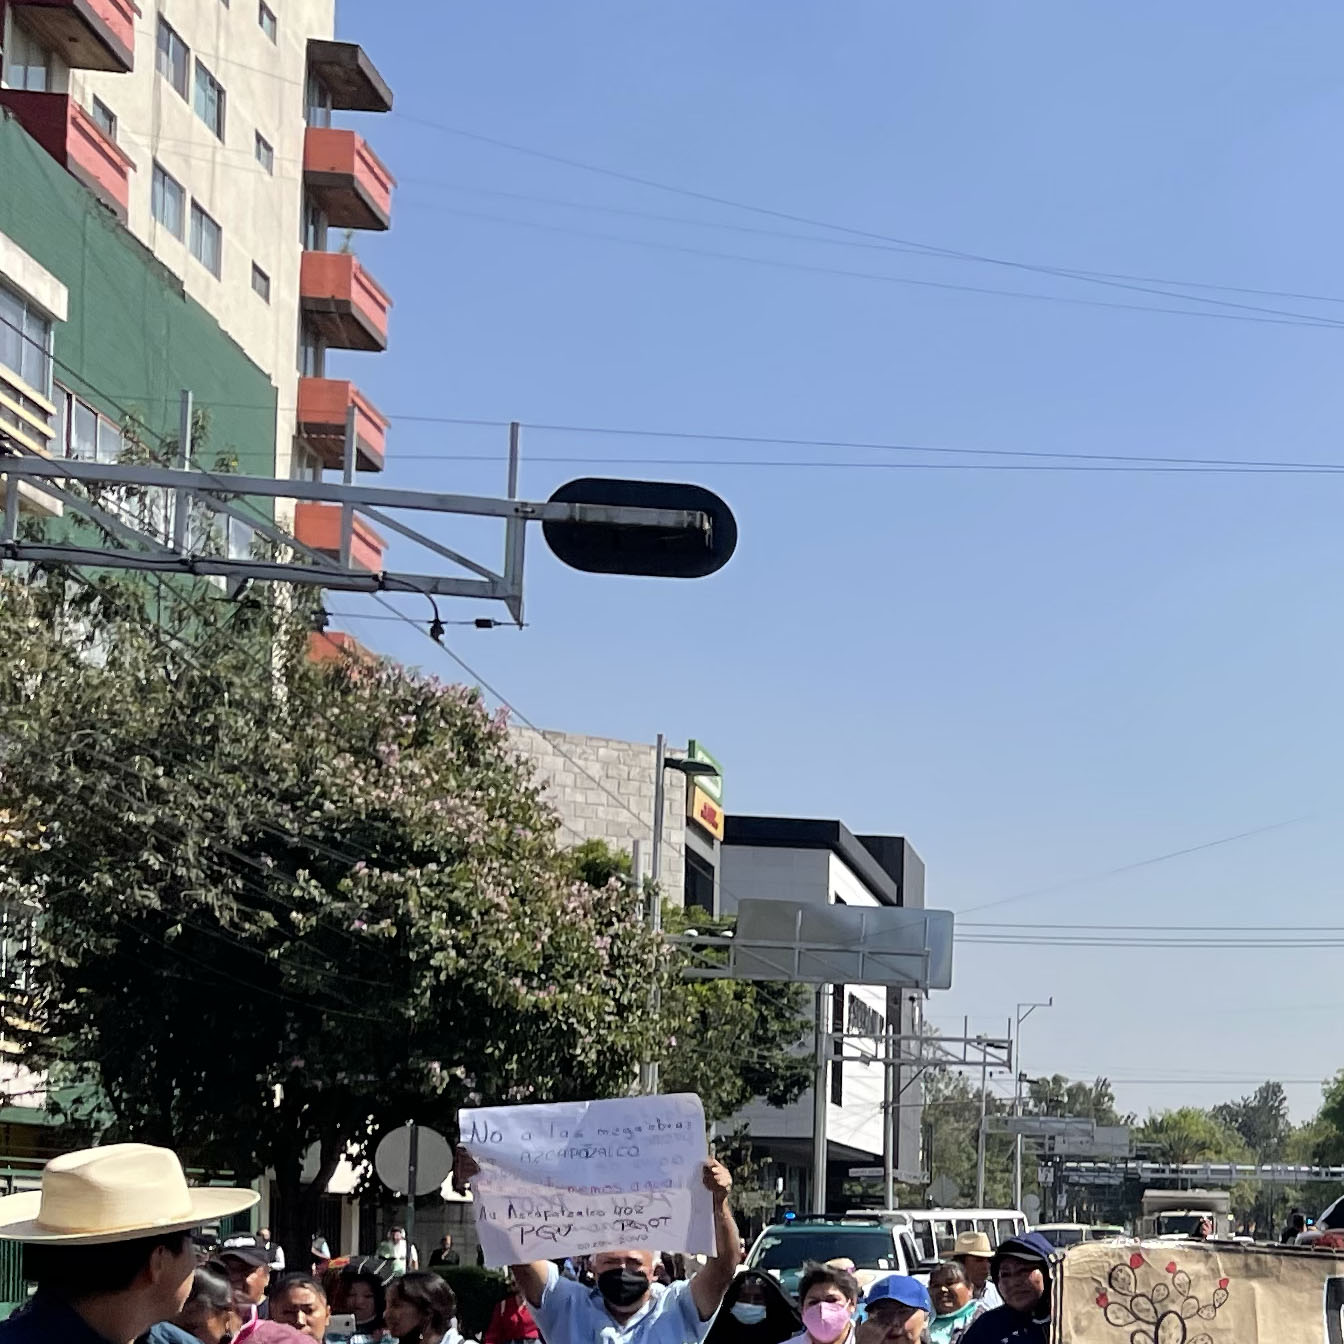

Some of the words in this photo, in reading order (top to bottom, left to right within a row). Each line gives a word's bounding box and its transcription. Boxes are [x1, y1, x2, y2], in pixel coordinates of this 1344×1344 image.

[470, 1119, 503, 1145] No
[521, 1131, 532, 1141] a
[548, 1120, 584, 1139] las
